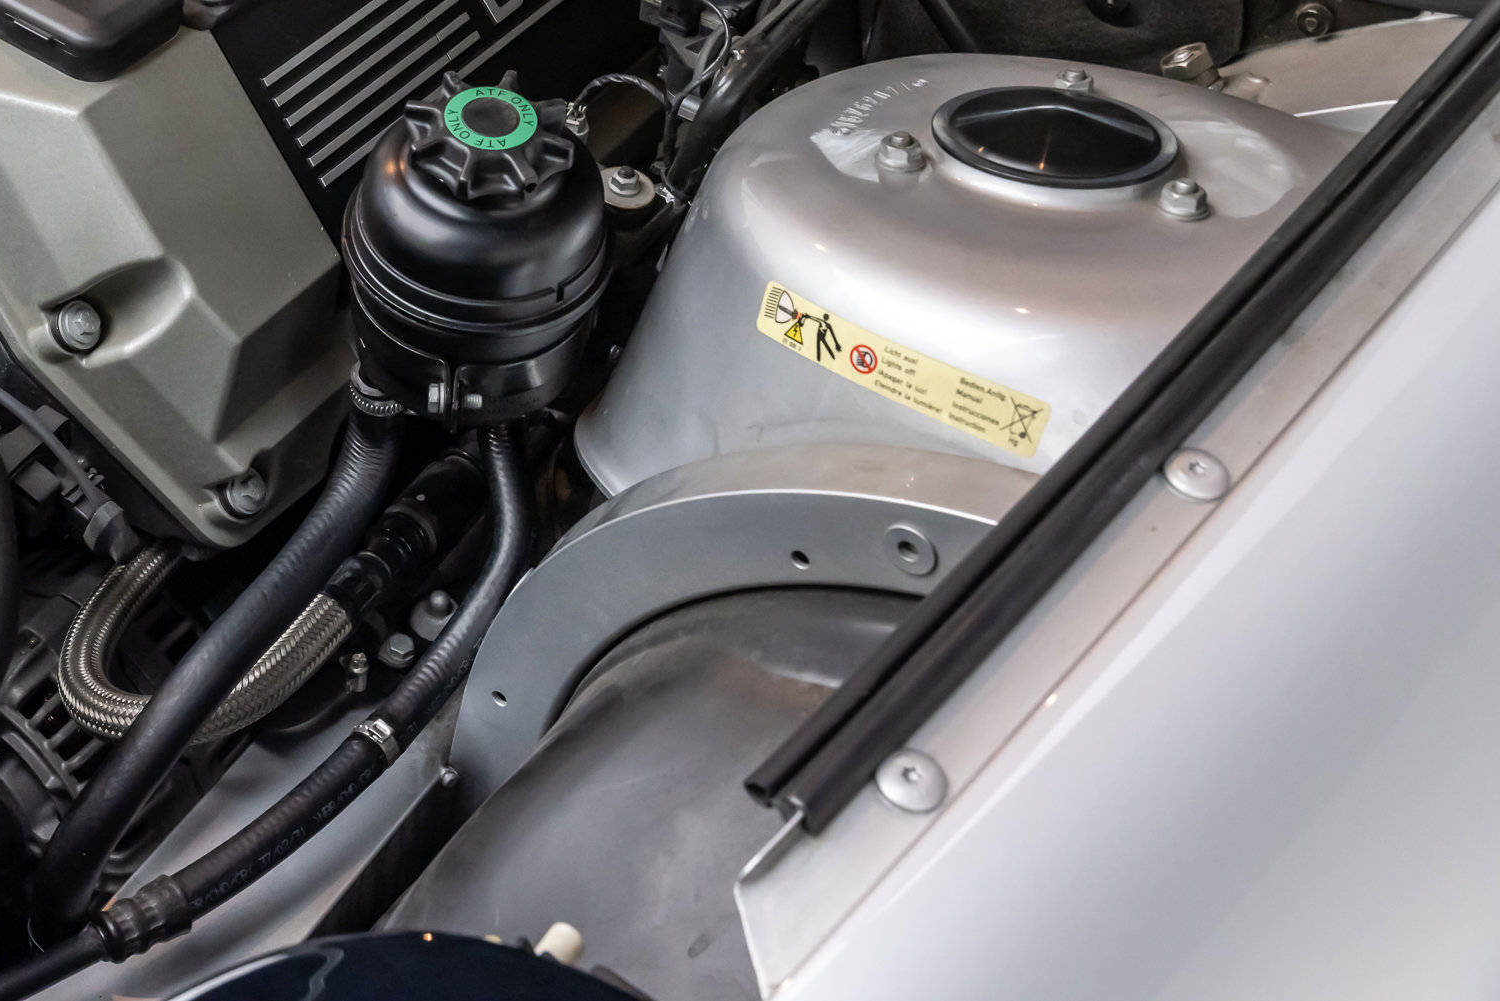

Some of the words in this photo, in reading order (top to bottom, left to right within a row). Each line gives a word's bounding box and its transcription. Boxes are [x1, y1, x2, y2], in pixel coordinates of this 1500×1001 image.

[475, 88, 508, 97] ATF
[511, 96, 534, 127] ONLY
[448, 109, 471, 140] ONLY
[475, 139, 506, 148] ATF
[884, 345, 902, 358] Licht
[881, 357, 902, 372] Lights
[956, 388, 983, 403] Manual
